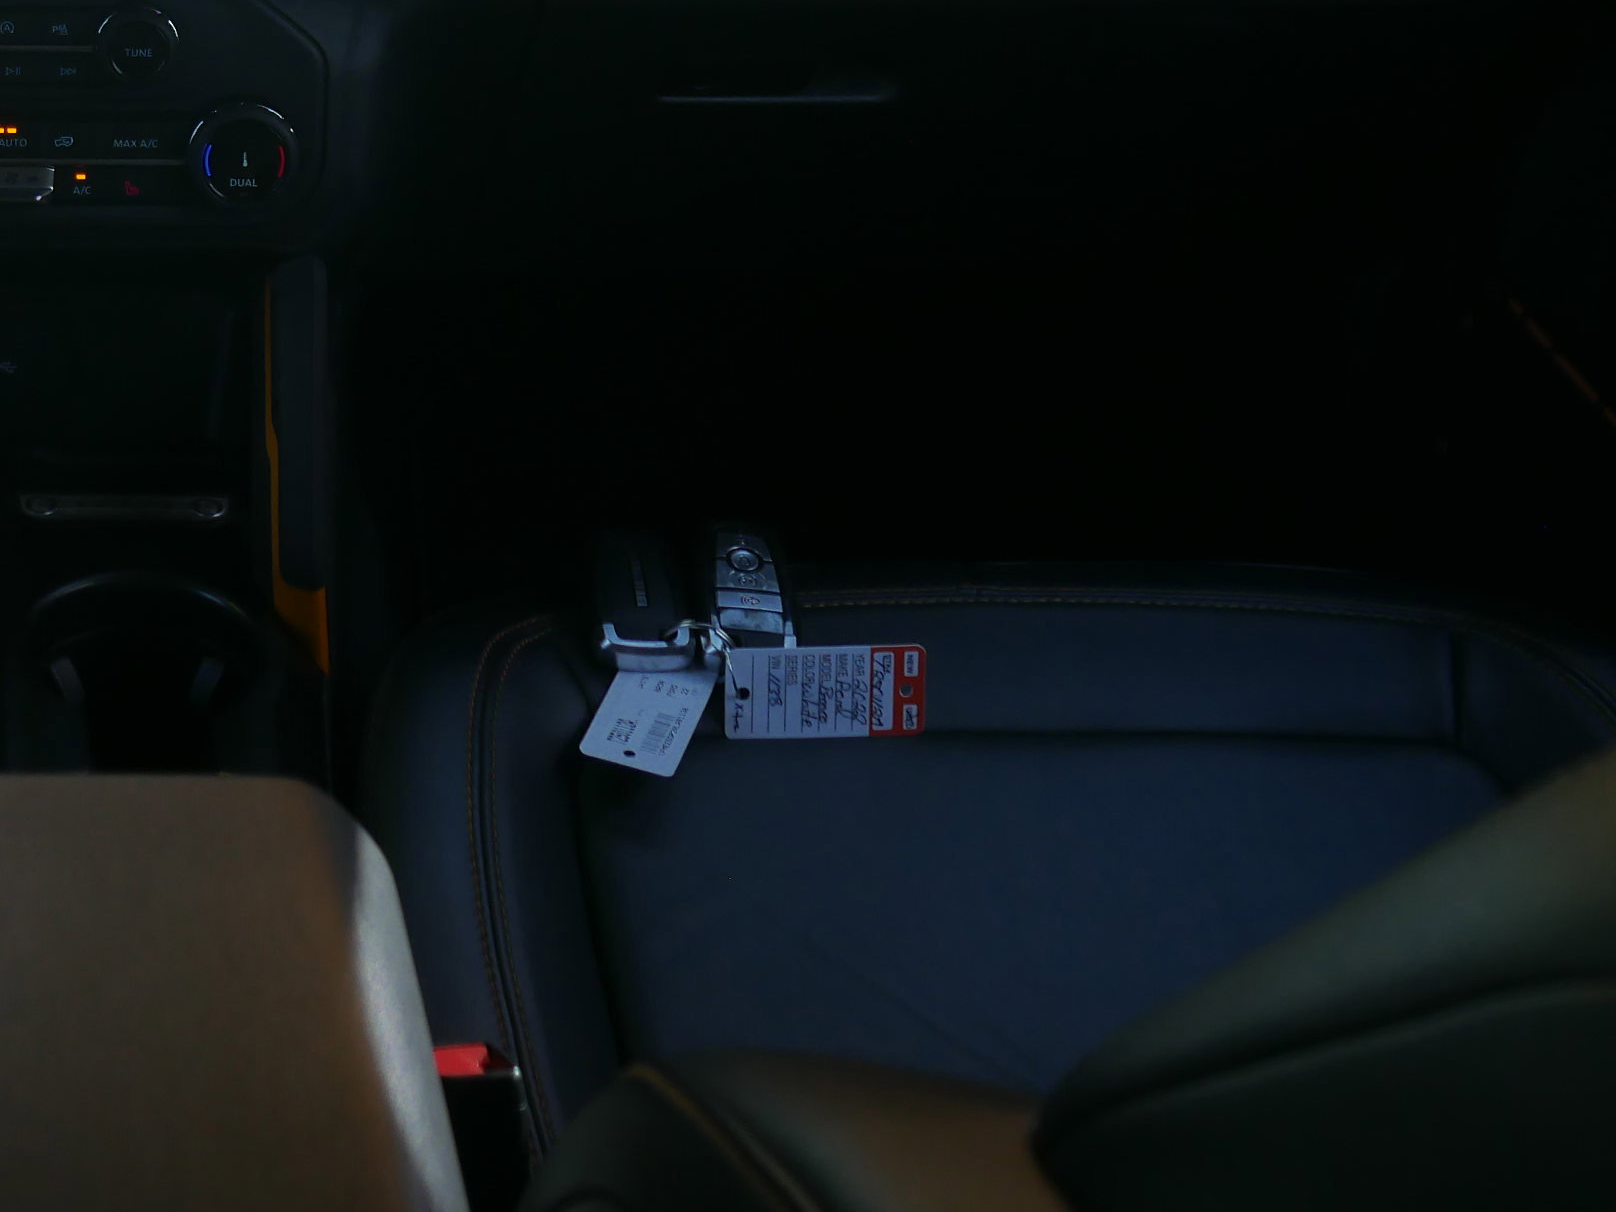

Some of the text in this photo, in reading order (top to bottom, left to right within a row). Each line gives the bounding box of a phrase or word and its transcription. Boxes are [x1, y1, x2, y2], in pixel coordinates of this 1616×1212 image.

[125, 48, 152, 58] TUNE
[114, 138, 158, 148] MAX A/C
[73, 185, 92, 195] A/C
[230, 178, 258, 188] DUAL
[806, 655, 815, 684] COLOR
[822, 654, 831, 681] MODEL
[839, 654, 848, 677] MAKE
[855, 654, 864, 676] YEAR
